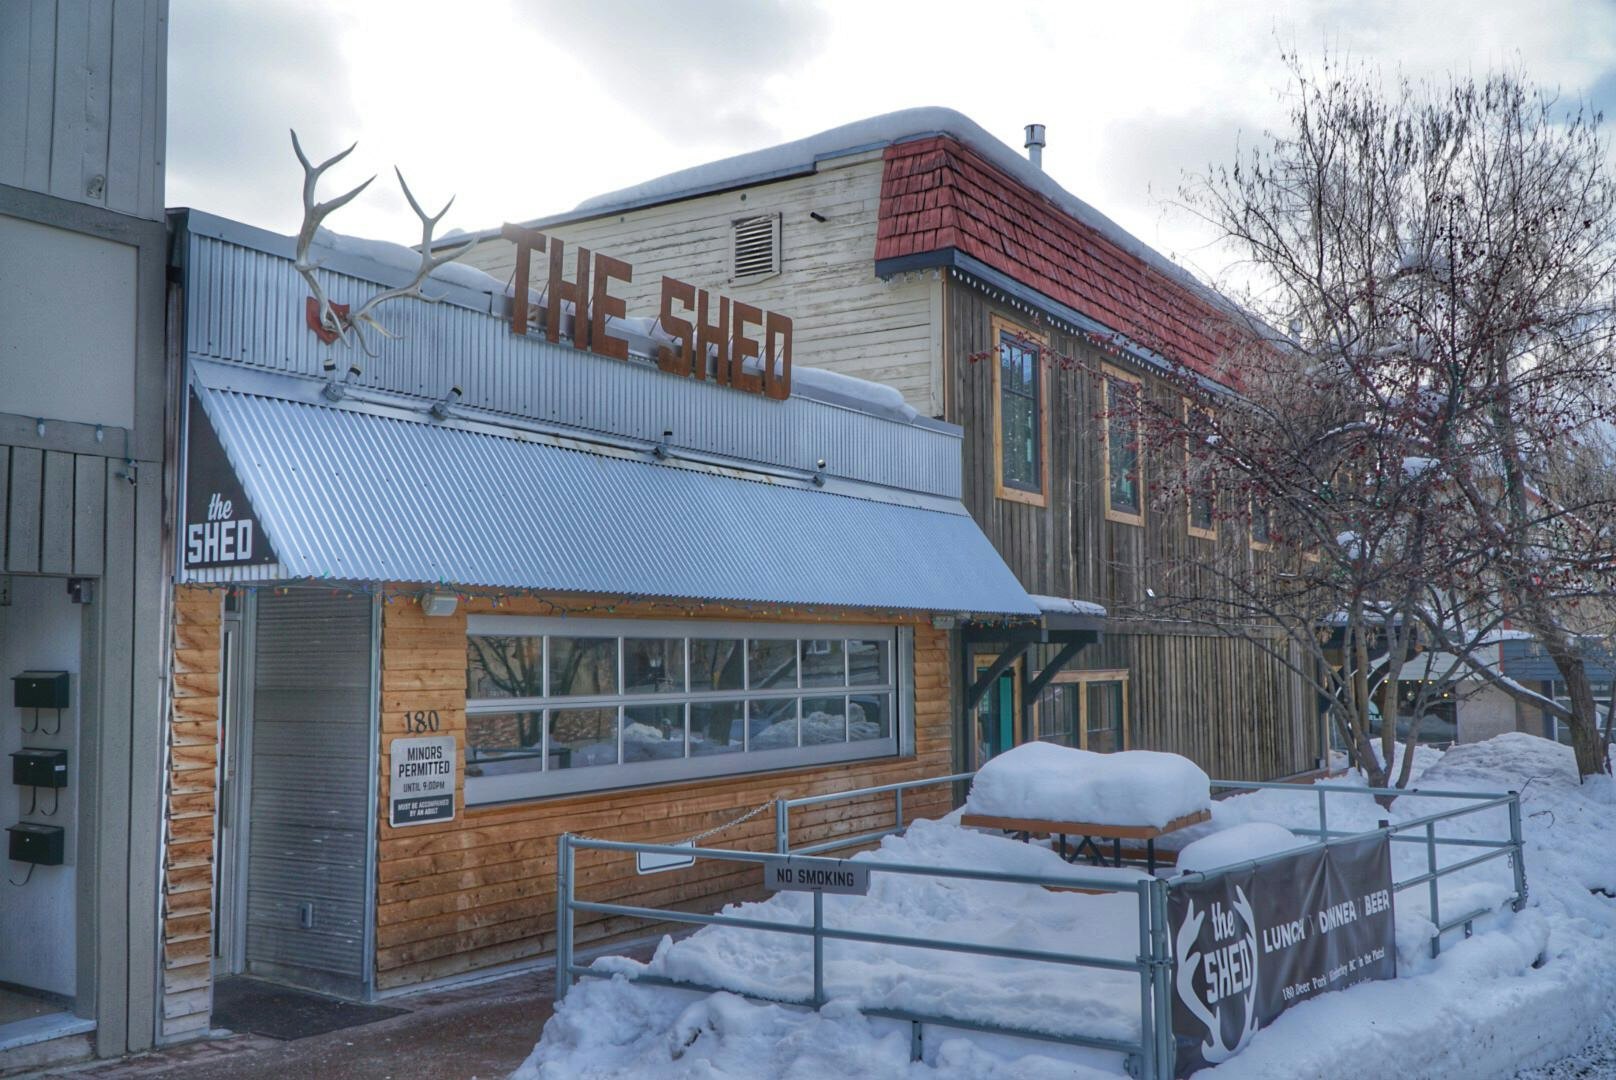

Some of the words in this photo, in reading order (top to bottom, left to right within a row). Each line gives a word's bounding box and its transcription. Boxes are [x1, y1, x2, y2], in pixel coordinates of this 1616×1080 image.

[501, 222, 632, 361] THE
[657, 275, 793, 400] SHED
[208, 493, 233, 520] the
[188, 519, 253, 563] SHED
[404, 710, 440, 733] 180
[407, 746, 442, 761] MINORS
[398, 761, 450, 777] PERMITTED
[403, 782, 421, 793] UNTIL
[411, 802, 419, 810] BE
[777, 868, 793, 884] NO
[798, 869, 855, 887] SMOKING
[1211, 901, 1236, 942] the
[1263, 918, 1306, 953] LUNCH
[1319, 900, 1357, 934] DINNER
[1364, 889, 1390, 916] BEER
[1203, 942, 1251, 1004] SHED
[1282, 987, 1296, 1001] 180
[1295, 981, 1311, 996] Deer
[1312, 974, 1328, 990] Park
